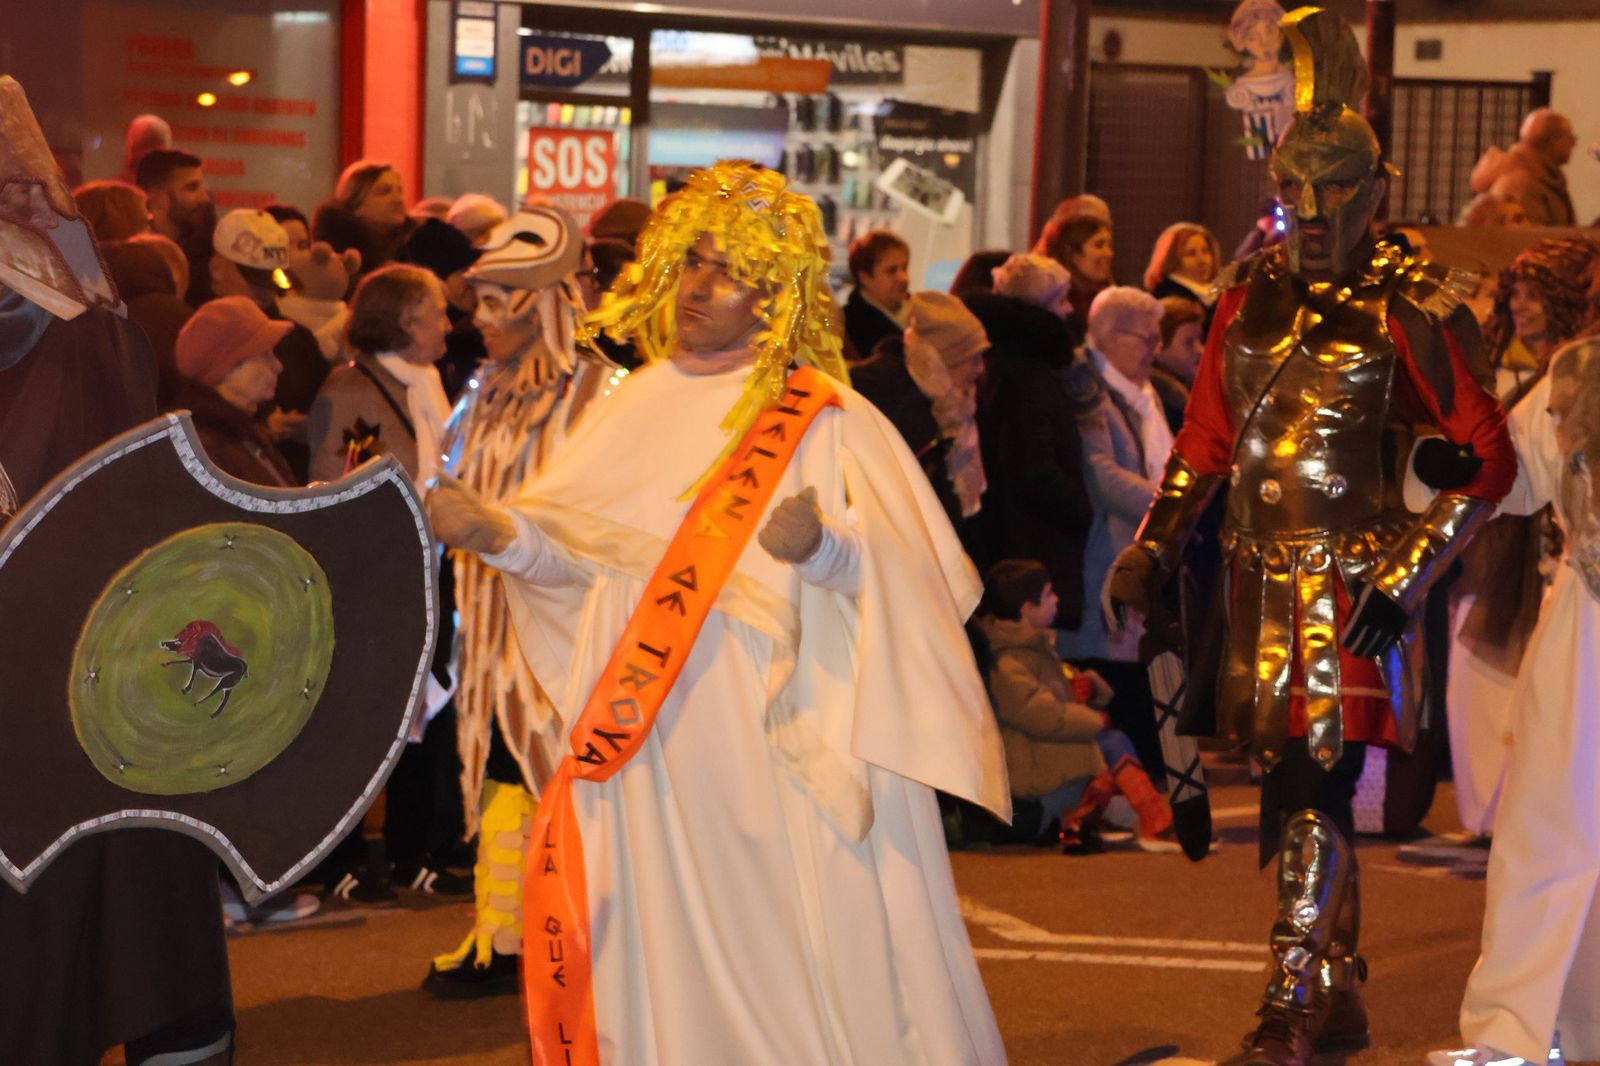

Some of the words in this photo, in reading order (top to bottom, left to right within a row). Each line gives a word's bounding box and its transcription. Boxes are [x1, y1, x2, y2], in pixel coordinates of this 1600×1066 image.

[526, 47, 581, 76] DIGI
[532, 136, 609, 190] SOS
[575, 641, 672, 766] TROYA
[543, 820, 558, 877] LA
